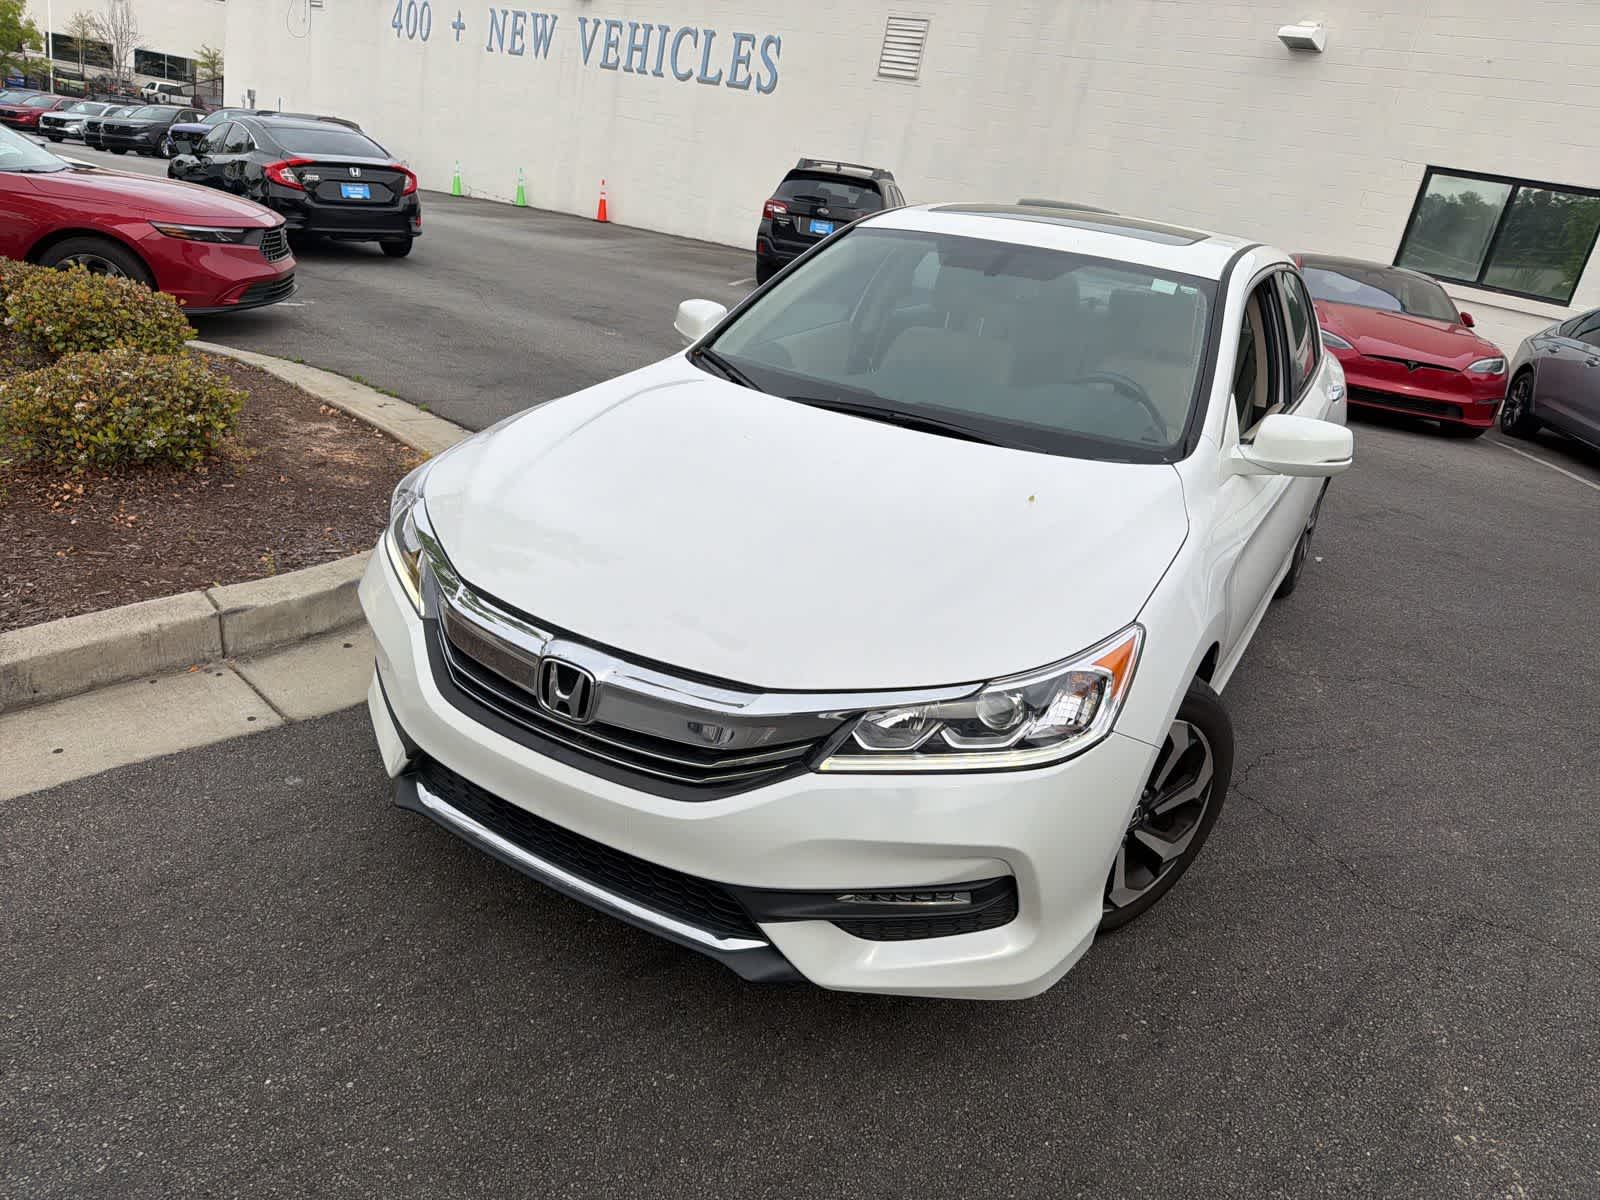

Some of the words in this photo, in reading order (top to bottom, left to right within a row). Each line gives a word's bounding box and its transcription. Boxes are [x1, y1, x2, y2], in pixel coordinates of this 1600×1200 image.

[391, 0, 432, 42] 400
[486, 7, 558, 60] NEW
[578, 16, 782, 95] VEHICLES
